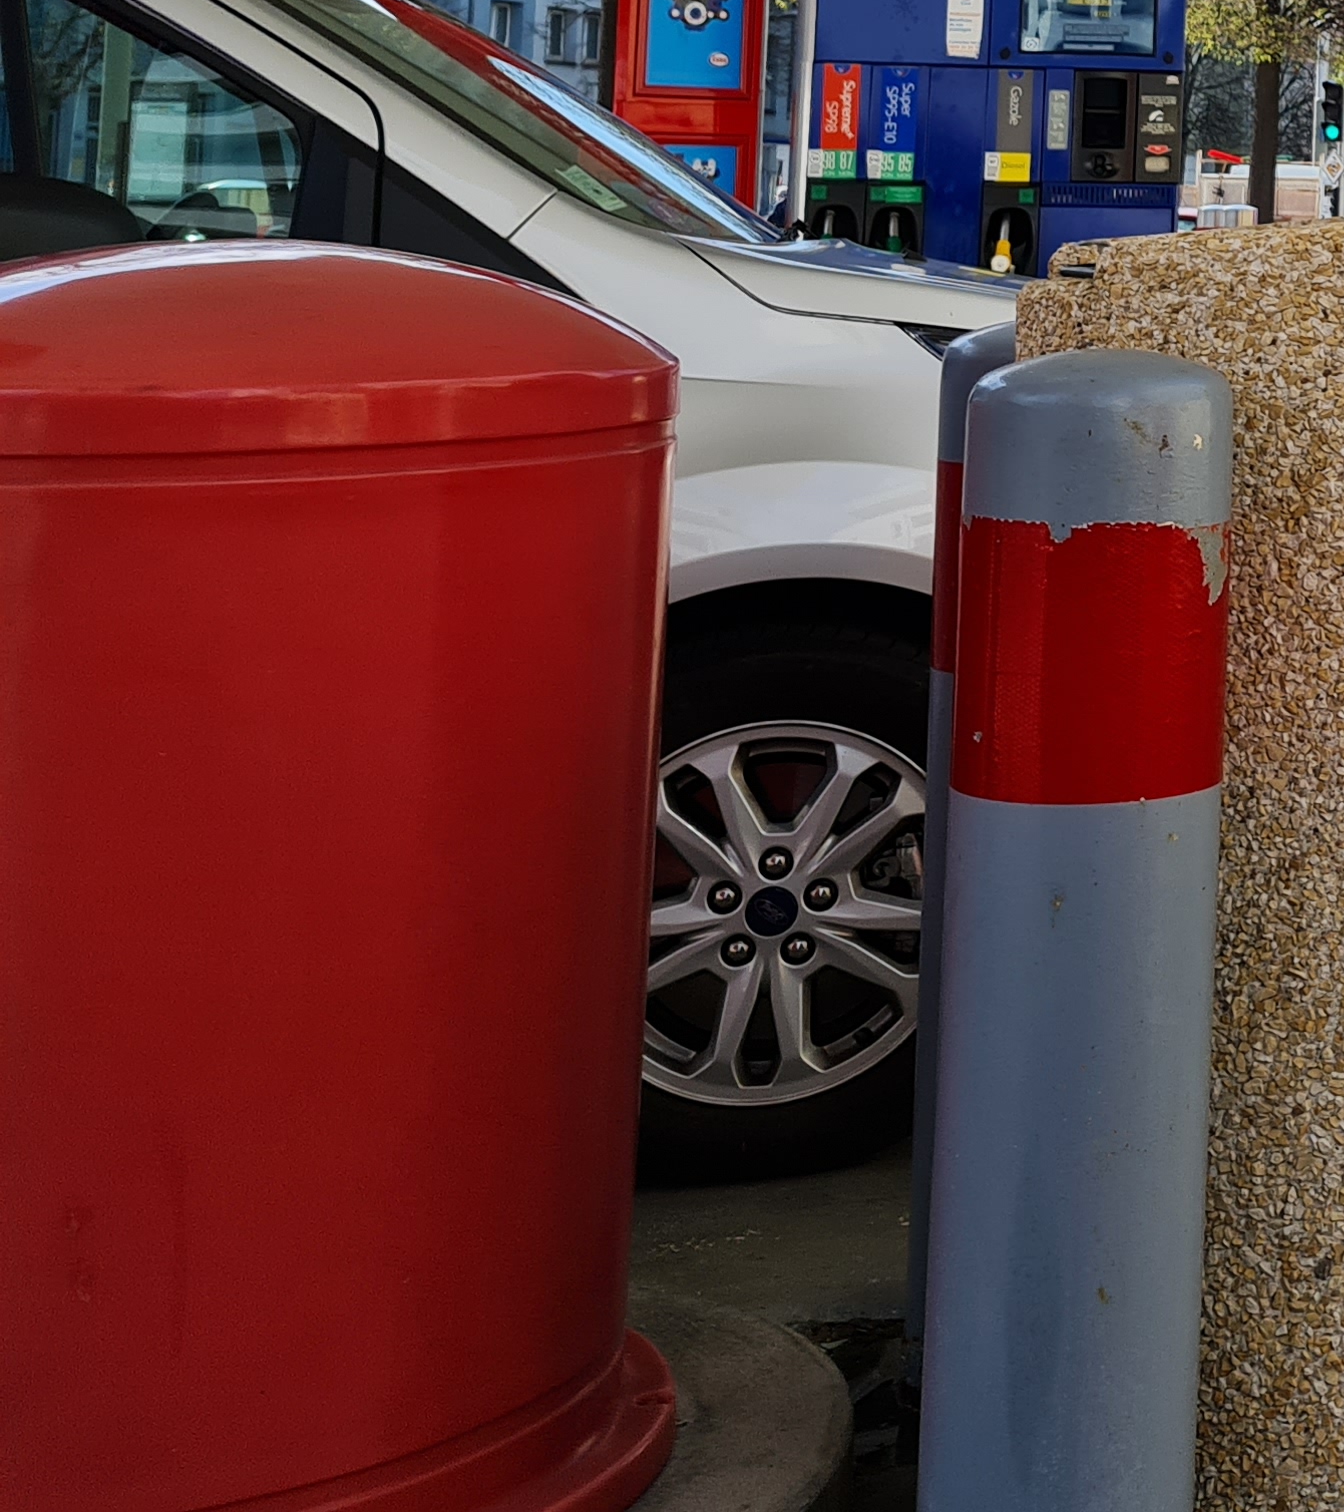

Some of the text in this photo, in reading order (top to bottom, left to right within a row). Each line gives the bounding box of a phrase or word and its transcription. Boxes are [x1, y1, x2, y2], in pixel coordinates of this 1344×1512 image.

[825, 100, 839, 133] SP98
[884, 85, 899, 144] SP95-E10
[900, 82, 915, 118] Super
[1009, 85, 1023, 126] Gazole
[840, 151, 854, 170] 87
[899, 153, 912, 172] 85
